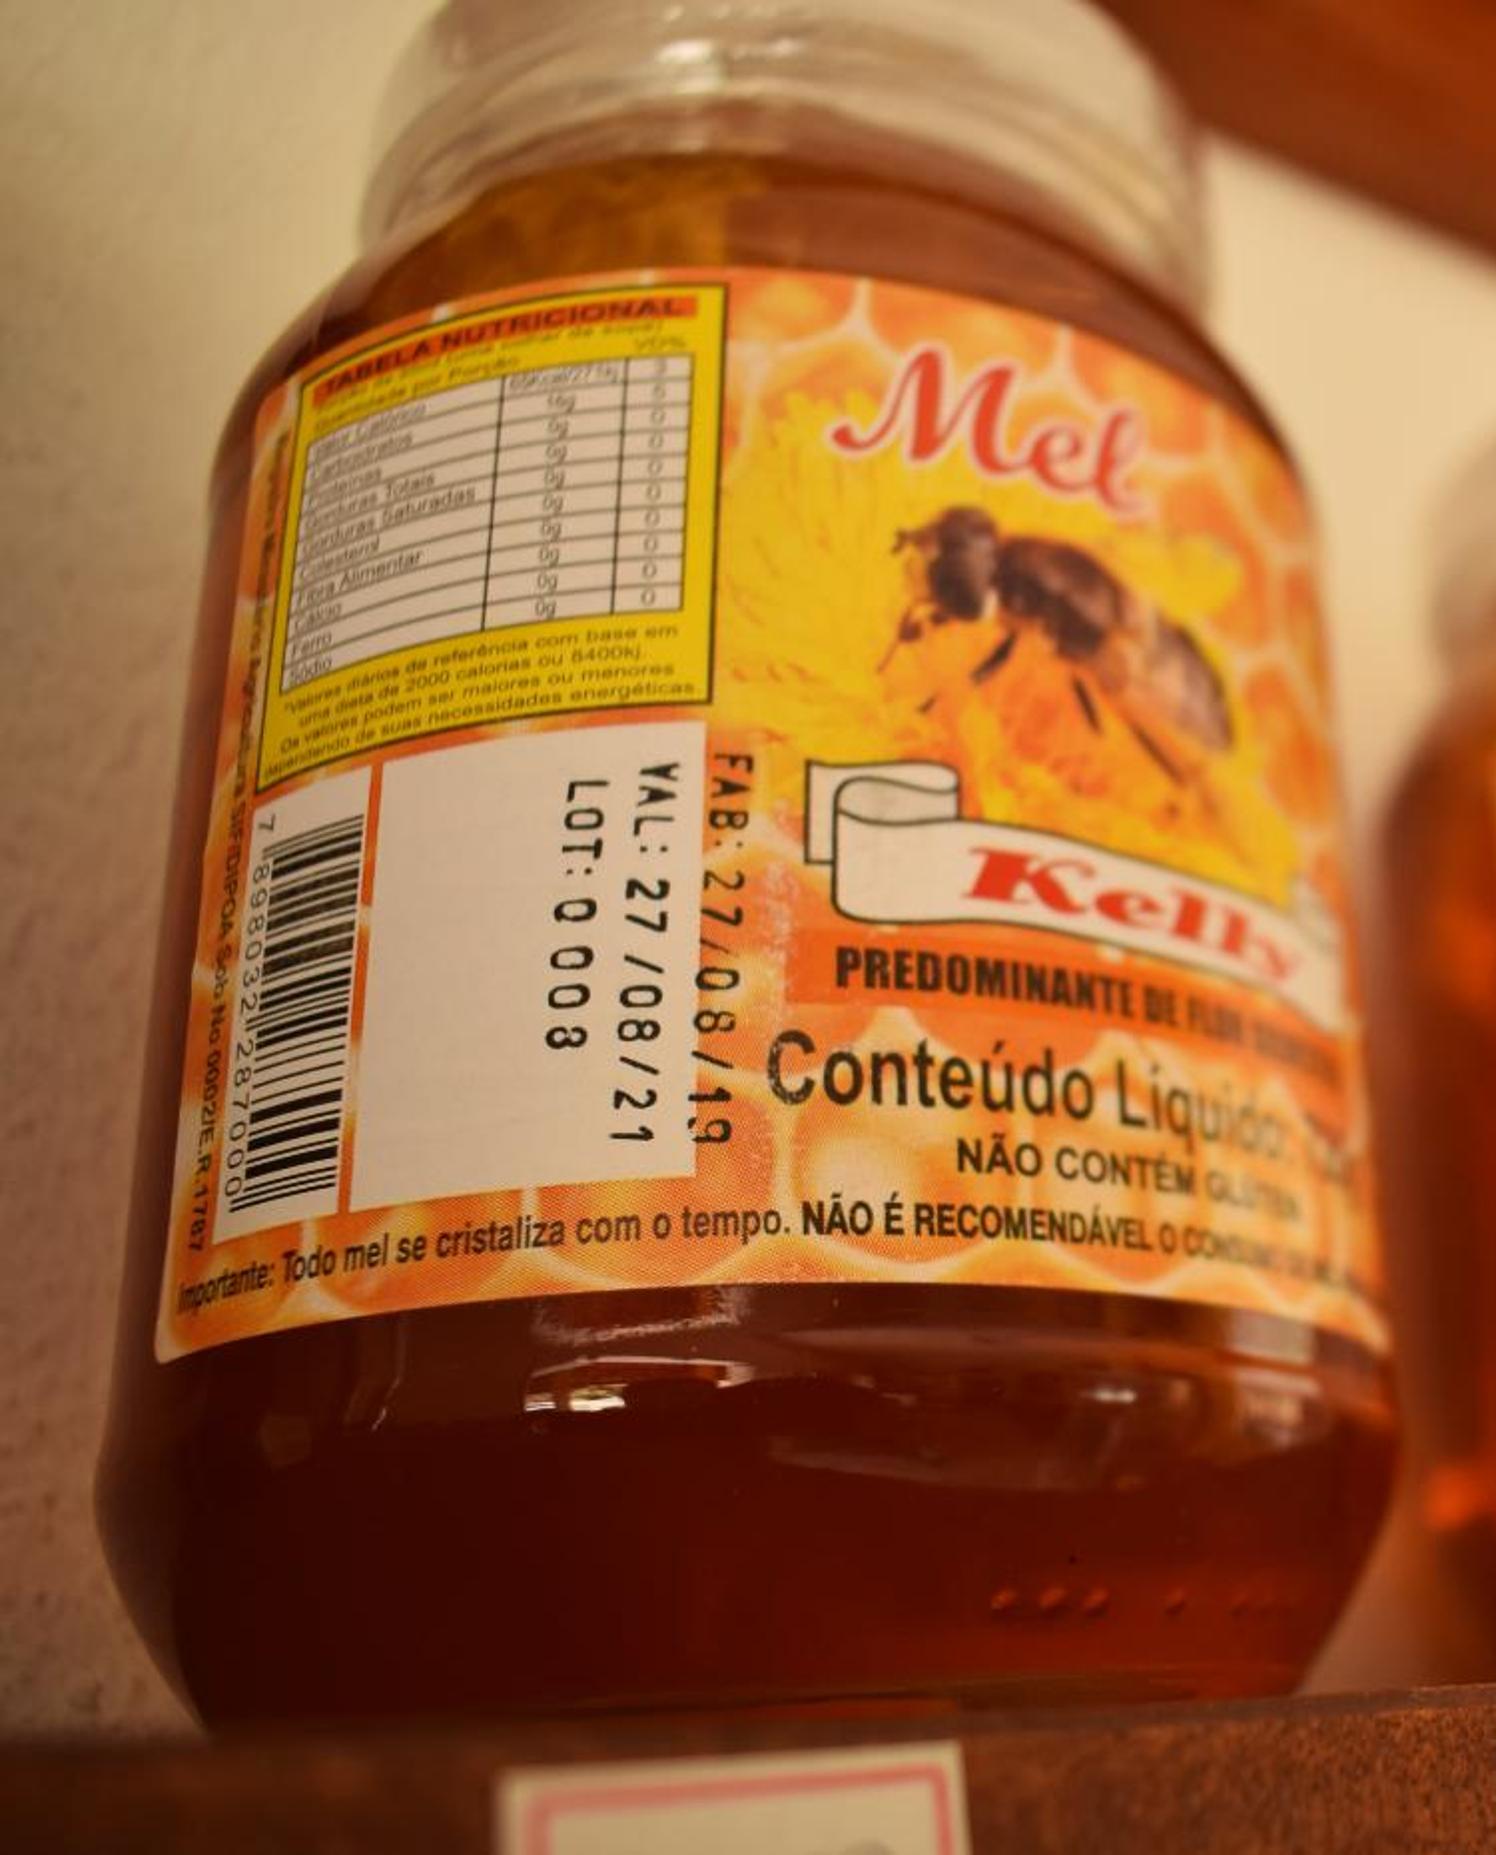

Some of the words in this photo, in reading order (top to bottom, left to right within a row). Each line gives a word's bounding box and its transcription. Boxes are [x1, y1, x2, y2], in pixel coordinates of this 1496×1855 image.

[325, 338, 433, 397] TABELA
[440, 298, 683, 348] NUTRICIONAL
[829, 347, 1147, 517] Mel
[382, 487, 477, 524] Saturadas
[338, 552, 422, 591] Alimentar
[364, 697, 422, 723] podem
[428, 690, 454, 705] ser
[462, 675, 541, 700] maiores
[547, 671, 574, 685] ou
[581, 665, 676, 682] menores
[378, 683, 400, 698] de
[405, 669, 450, 691] 2000
[456, 656, 531, 681] calorias
[537, 654, 564, 667] ou
[405, 660, 428, 674] de
[433, 640, 528, 666] referência
[535, 635, 579, 650] com
[586, 625, 638, 643] base
[645, 627, 679, 639] em
[381, 716, 422, 735] suas
[428, 693, 564, 724] necessidades
[570, 682, 695, 701] energéticas
[257, 813, 275, 832] 7
[561, 778, 610, 875] LOT:
[632, 762, 680, 853] VAL:
[708, 753, 755, 848] FAB:
[966, 847, 1300, 983] Kelly
[608, 877, 671, 1141] 27/08/21
[687, 869, 746, 1144] 27/08/19
[835, 946, 1133, 1019] PREDOMINANTE
[1143, 984, 1180, 1027] DE
[766, 1029, 1096, 1121] Conteúdo
[956, 1130, 1043, 1178] NÃO
[1055, 1146, 1195, 1198] CONTÉM
[282, 1245, 337, 1285] Todo
[343, 1231, 390, 1273] mel
[396, 1235, 428, 1264] se
[435, 1214, 566, 1259] cristaliza
[575, 1214, 642, 1245] com
[653, 1211, 673, 1240] o
[681, 1204, 792, 1246] tempo.
[801, 1193, 874, 1237] NÃO
[884, 1191, 905, 1235] É
[914, 1199, 1154, 1253] RECOMENDÁVEL
[1159, 1219, 1178, 1255] O
